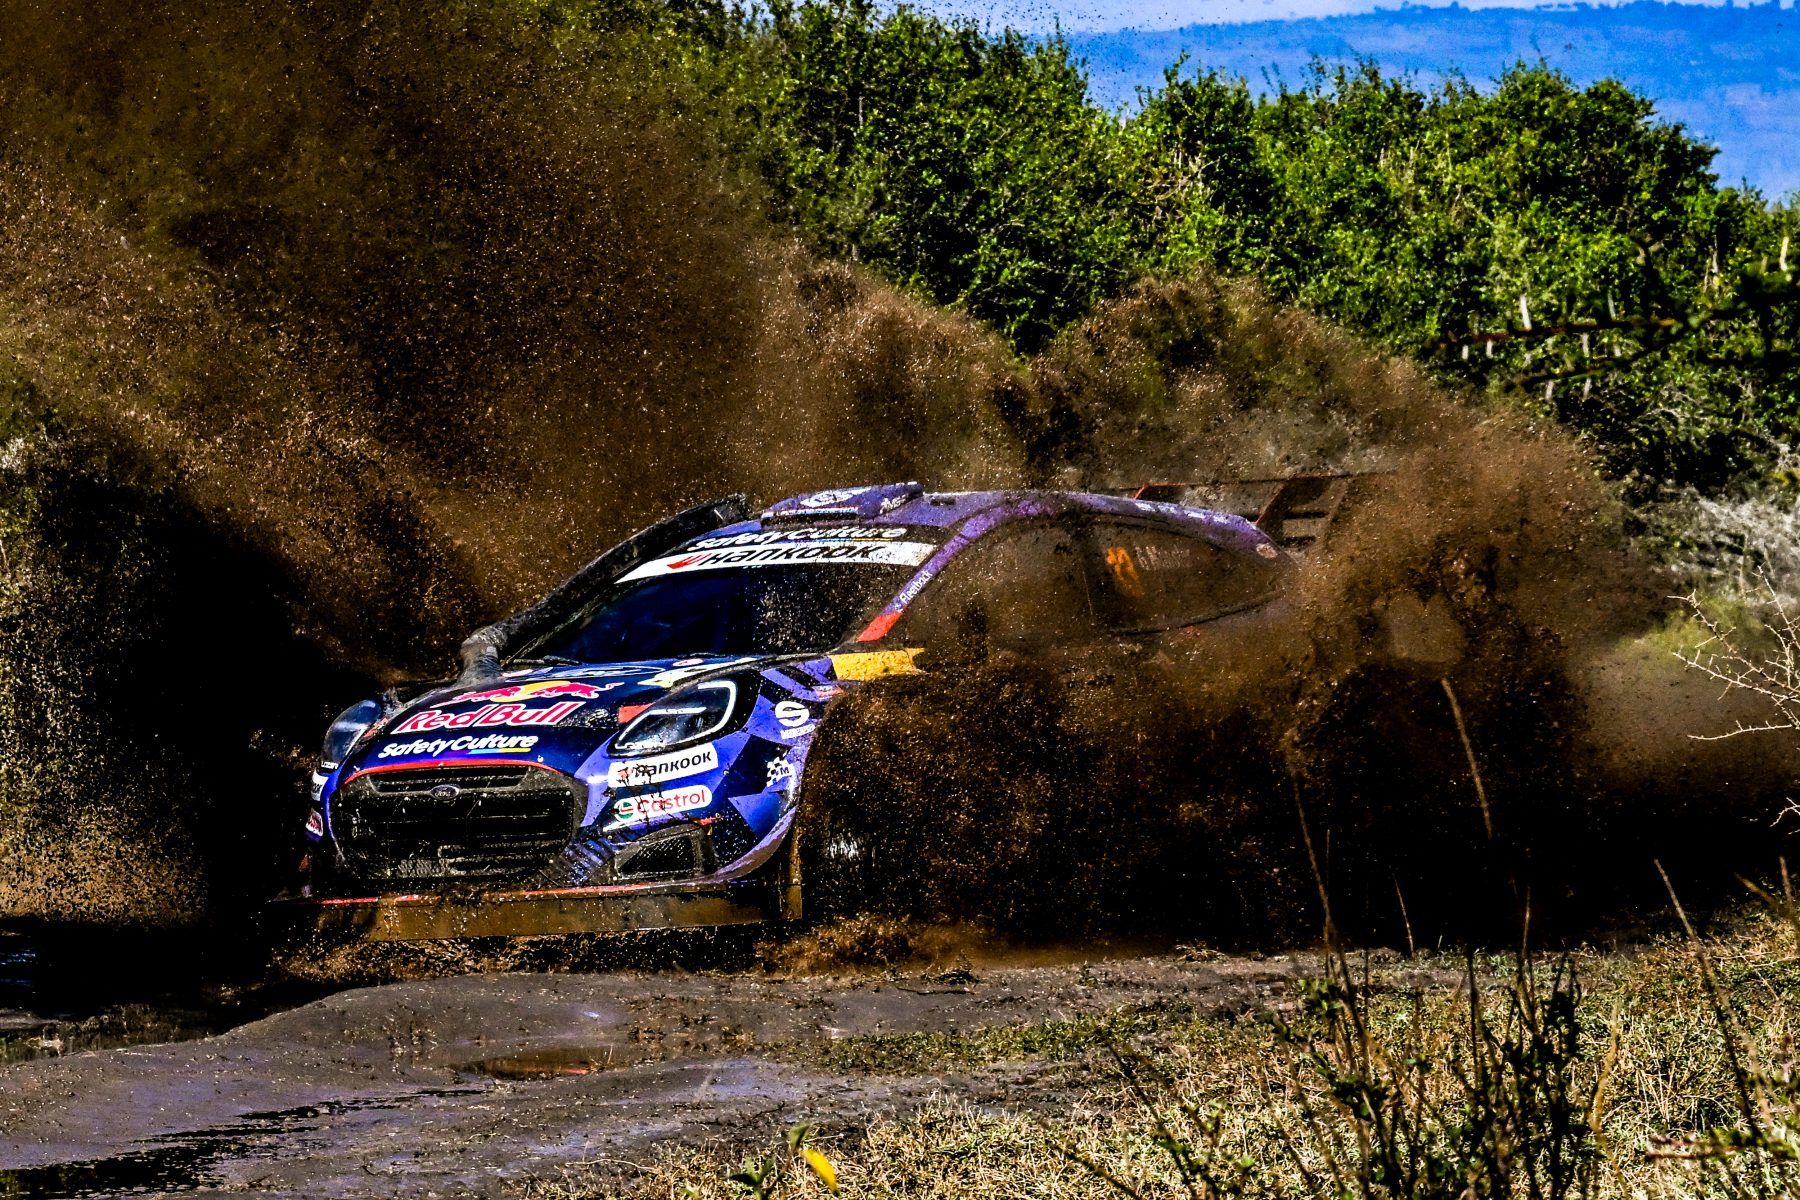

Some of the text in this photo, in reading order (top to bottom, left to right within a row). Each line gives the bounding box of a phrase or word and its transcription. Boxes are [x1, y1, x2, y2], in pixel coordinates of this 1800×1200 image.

[391, 703, 499, 735] Red
[477, 701, 587, 727] Bull
[378, 734, 539, 758] SafetyCulture
[637, 789, 706, 814] Castrol
